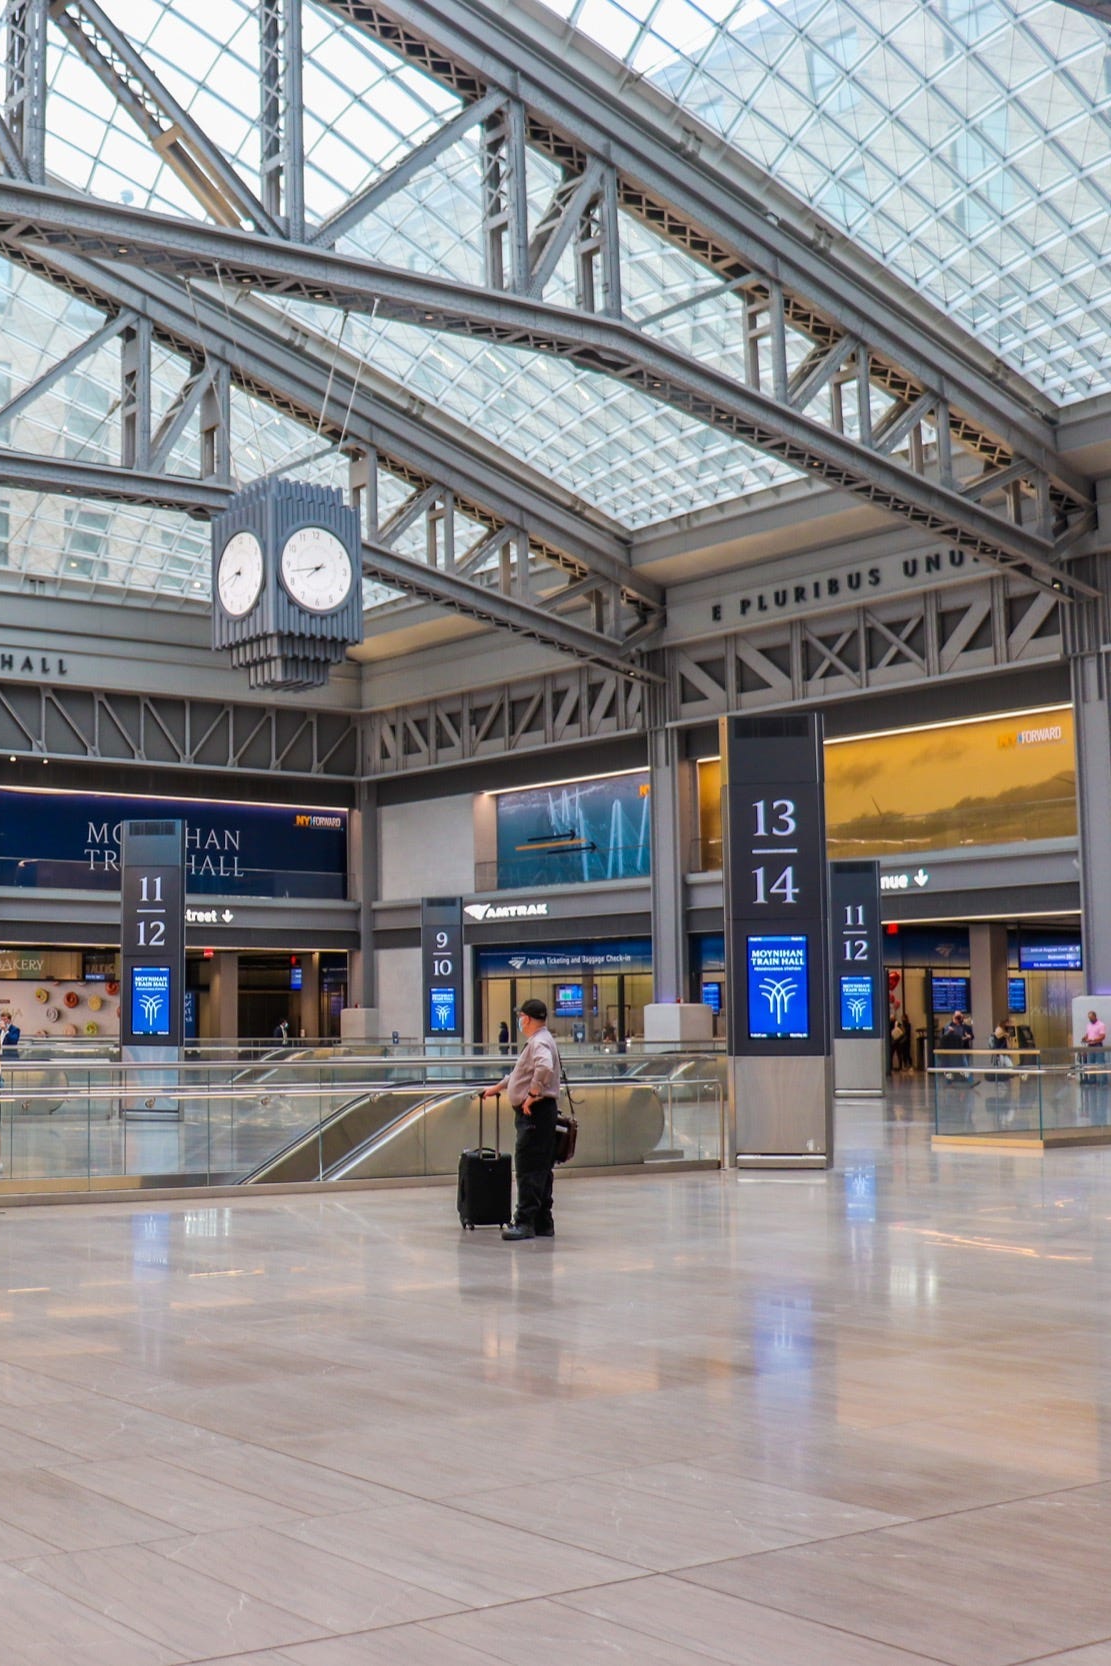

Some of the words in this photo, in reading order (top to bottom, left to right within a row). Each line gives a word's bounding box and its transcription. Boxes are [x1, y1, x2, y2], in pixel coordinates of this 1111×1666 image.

[711, 604, 722, 622] E
[740, 568, 881, 616] PLURIBUS
[902, 550, 980, 578] UNU
[1, 653, 68, 675] HALL
[1021, 726, 1062, 744] FORWARD
[295, 815, 310, 826] NY
[312, 816, 342, 828] FORWARD
[752, 799, 797, 837] 13
[87, 821, 240, 851] MHAN
[139, 876, 164, 902] 11
[751, 866, 800, 904] 14
[881, 874, 908, 890] nue
[185, 909, 217, 923] treet
[486, 904, 548, 918] AMTRAK
[844, 905, 865, 926] 11
[137, 920, 166, 947] 12
[436, 931, 448, 949] 9
[527, 957, 545, 965] Amtrak
[547, 956, 570, 966] Ticketing
[571, 955, 581, 964] and
[582, 954, 605, 965] Baggage
[606, 953, 631, 963] Check-in
[751, 949, 804, 958] MOYNIHAN
[843, 940, 868, 961] 12
[433, 960, 452, 976] 10
[751, 957, 779, 966] TRAIN
[781, 957, 805, 966] HALL
